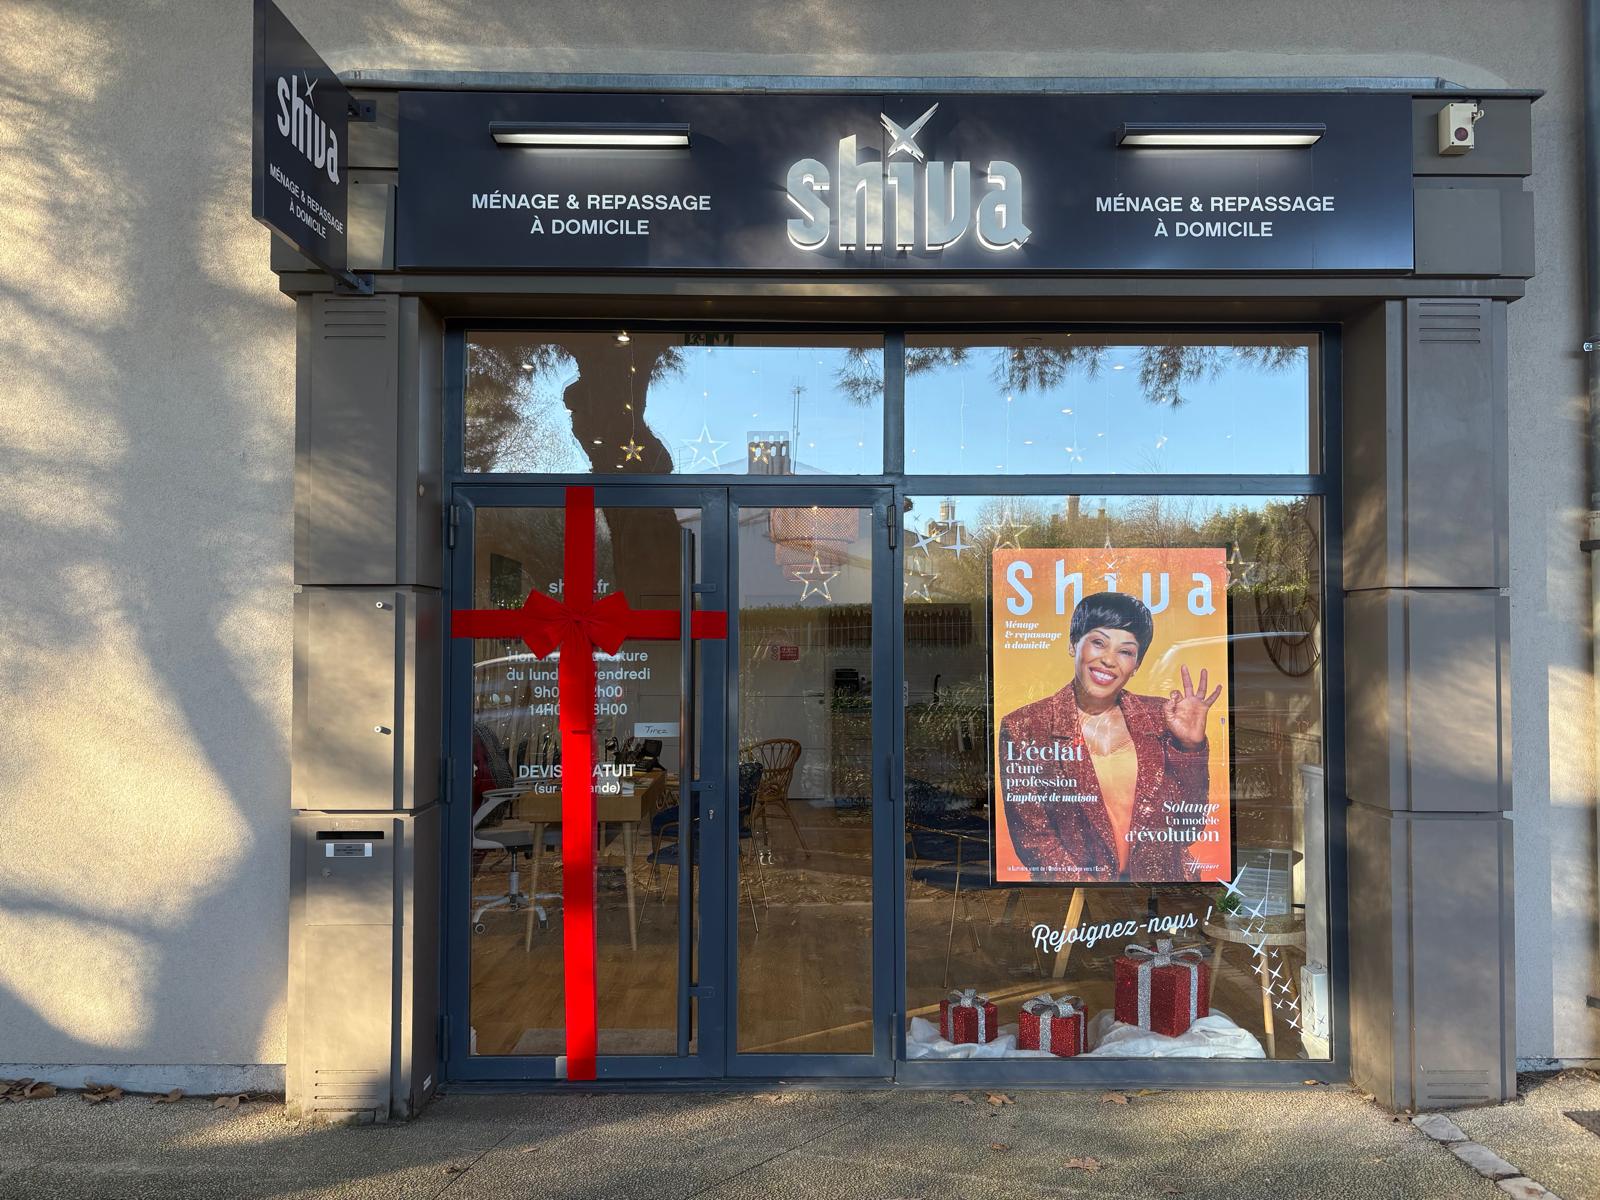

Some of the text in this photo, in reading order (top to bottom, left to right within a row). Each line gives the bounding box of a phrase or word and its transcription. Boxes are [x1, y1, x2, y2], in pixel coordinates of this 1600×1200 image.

[277, 71, 340, 185] shiva
[787, 103, 1033, 252] shiva
[270, 163, 344, 234] MÉNAGE & REPASSAGE
[472, 190, 712, 212] MÉNAGE & REPASSAGE
[1096, 192, 1335, 213] MÉNAGE & REPASSAGE
[289, 197, 326, 239] À DOMICILE
[530, 217, 650, 236] À DOMICILE
[1154, 218, 1273, 239] À DOMICILE
[1005, 620, 1040, 631] Ménage
[1014, 632, 1062, 641] repassage
[1012, 641, 1051, 649] domicile
[506, 668, 651, 681] du lund endredi
[534, 685, 561, 698] 9h0
[1006, 740, 1085, 762] L'éclat
[519, 764, 636, 778] DEVIS ATUIT
[1006, 763, 1043, 774] d'une
[534, 782, 557, 795] (sur
[1006, 775, 1078, 790] profession
[1006, 792, 1098, 804] Employé de maison
[1161, 800, 1220, 816] Solange
[1165, 815, 1220, 826] Un modèle
[1125, 827, 1220, 843] d'évolution
[1032, 912, 1199, 954] Rejoignez-nous
